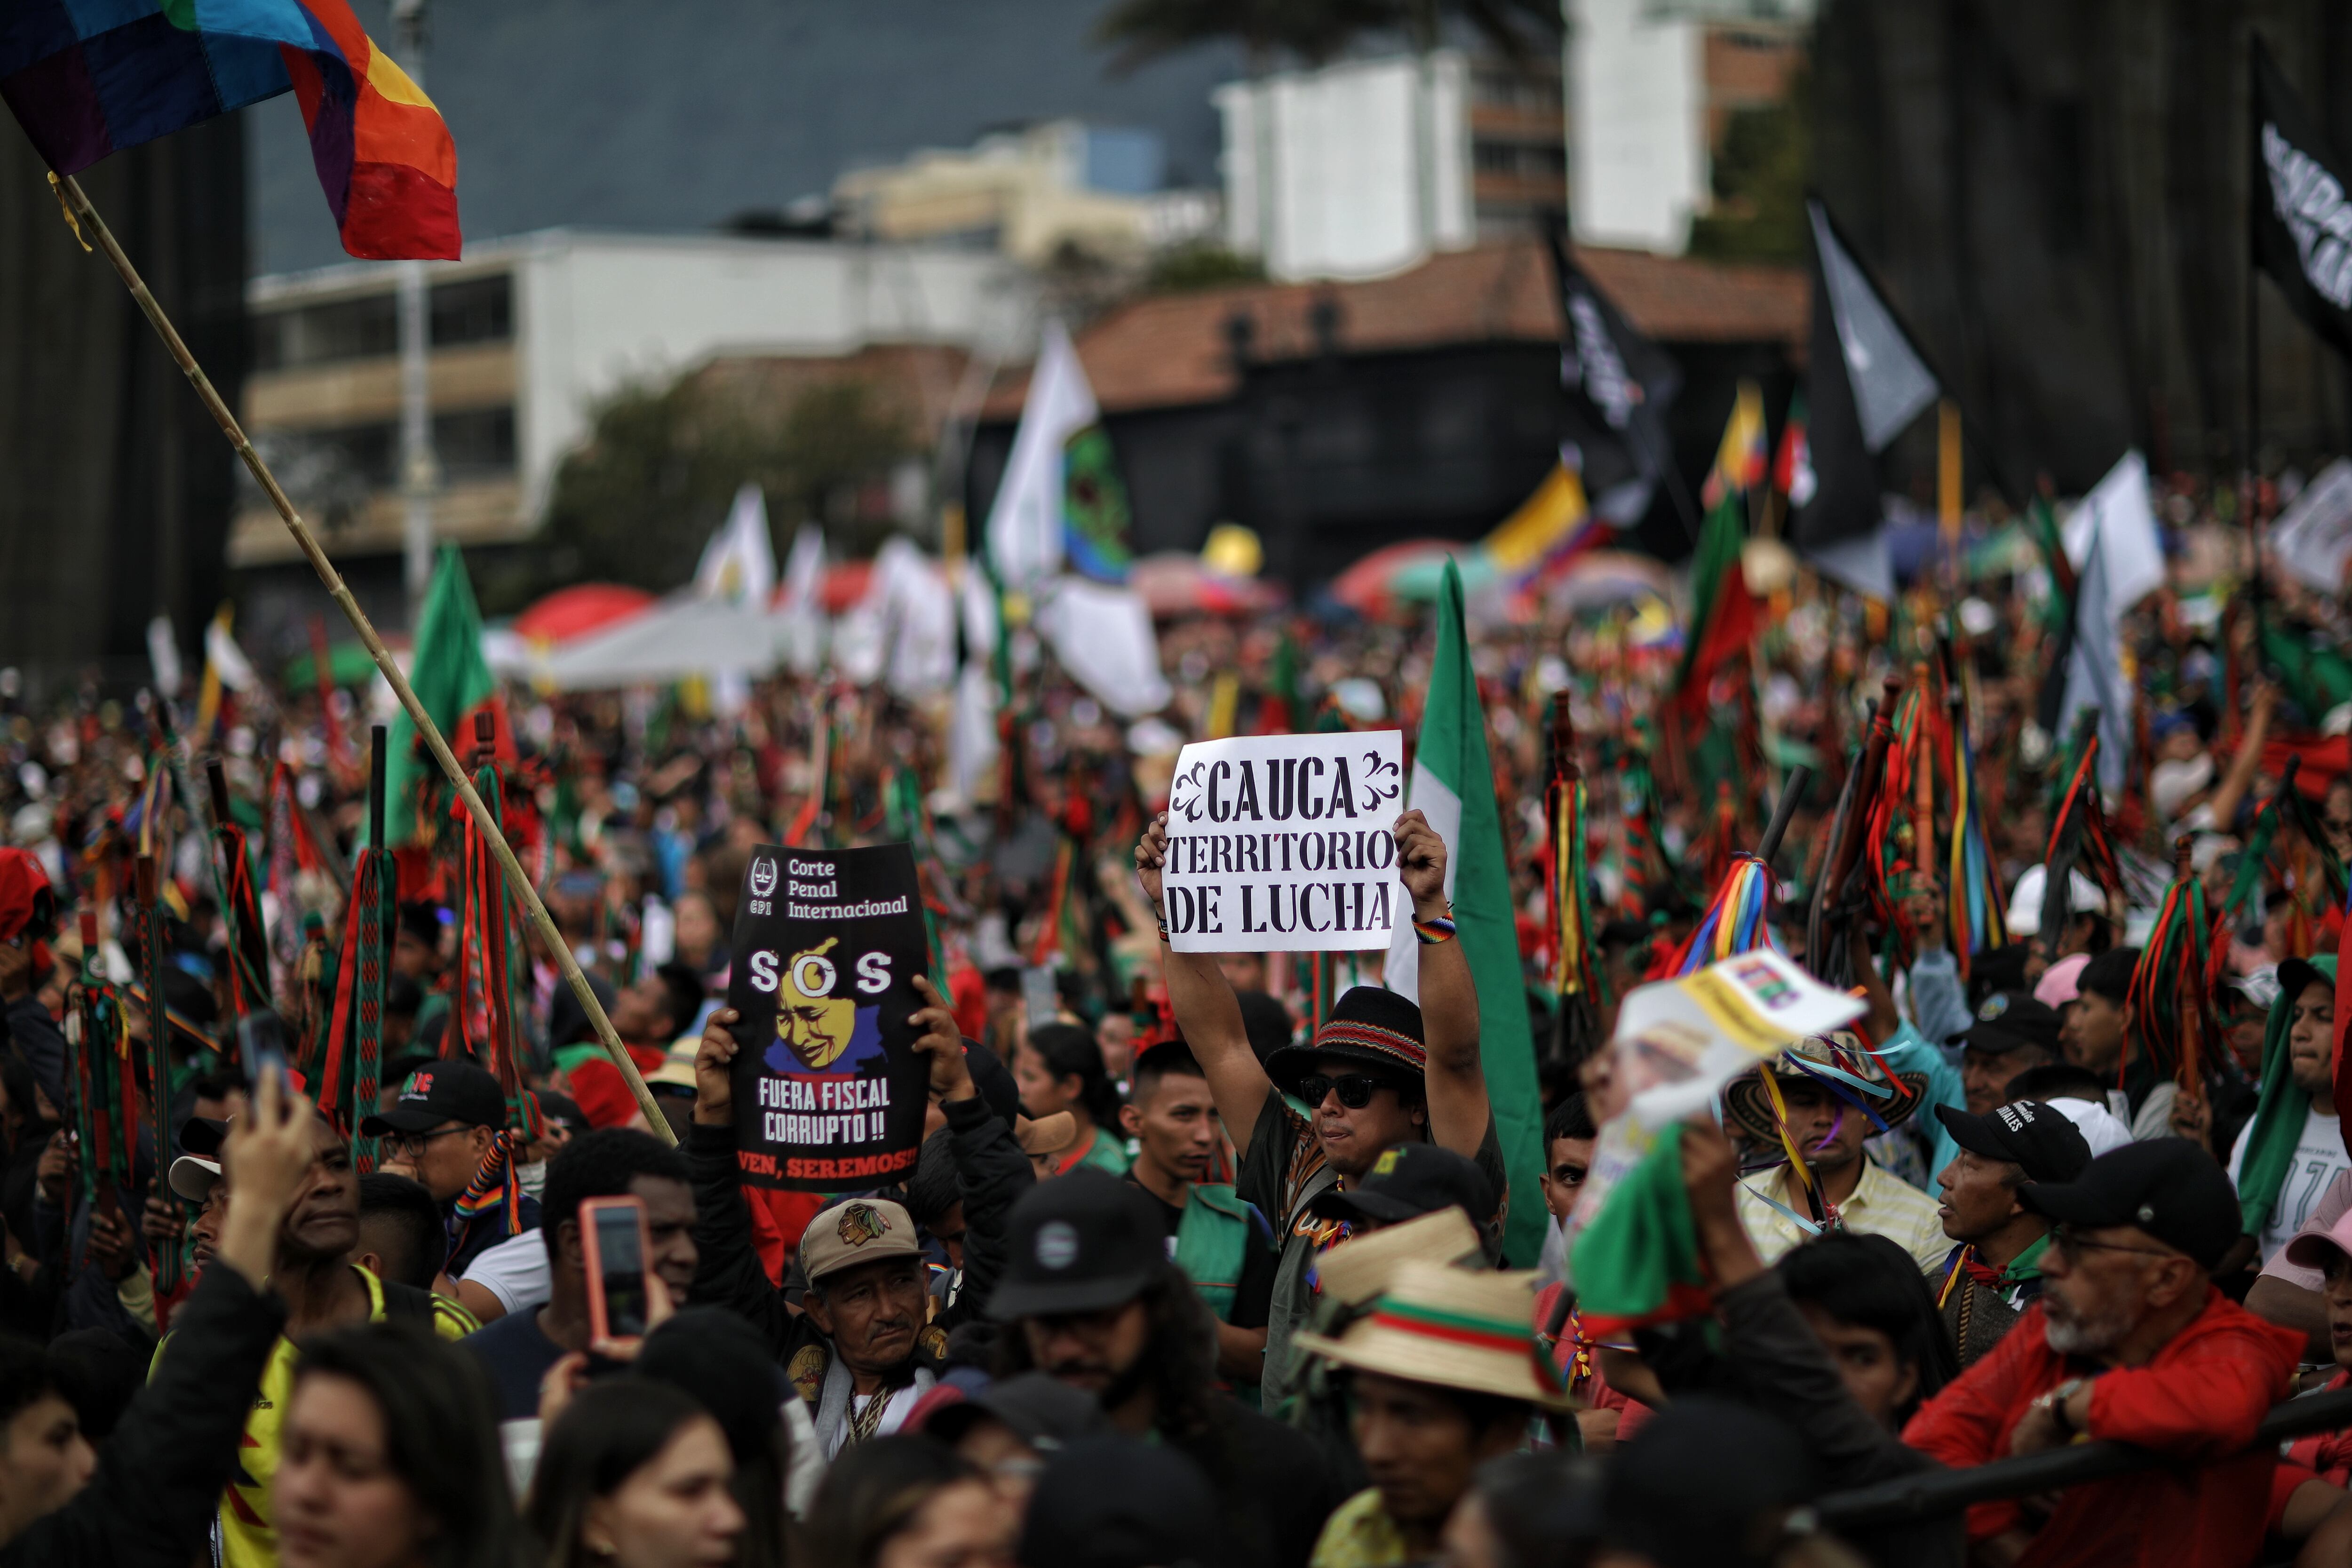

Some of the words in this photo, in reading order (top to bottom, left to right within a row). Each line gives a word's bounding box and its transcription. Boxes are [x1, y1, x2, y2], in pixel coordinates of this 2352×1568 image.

[1208, 757, 1358, 822] CAUCA
[789, 859, 835, 876] Corte
[1167, 830, 1393, 874] TERRITORIO
[789, 880, 837, 897] Penal
[750, 899, 771, 915] CPI
[789, 896, 908, 919] Internacional
[1167, 886, 1222, 933] DE
[1240, 882, 1391, 932] LUCHA
[751, 950, 891, 998] SOS
[760, 1078, 816, 1110] FUERA
[822, 1078, 890, 1110] FISCAL
[765, 1112, 865, 1145] CORRUPTO
[738, 1151, 782, 1179] VEN,
[787, 1148, 917, 1178] SEREMOS!!
